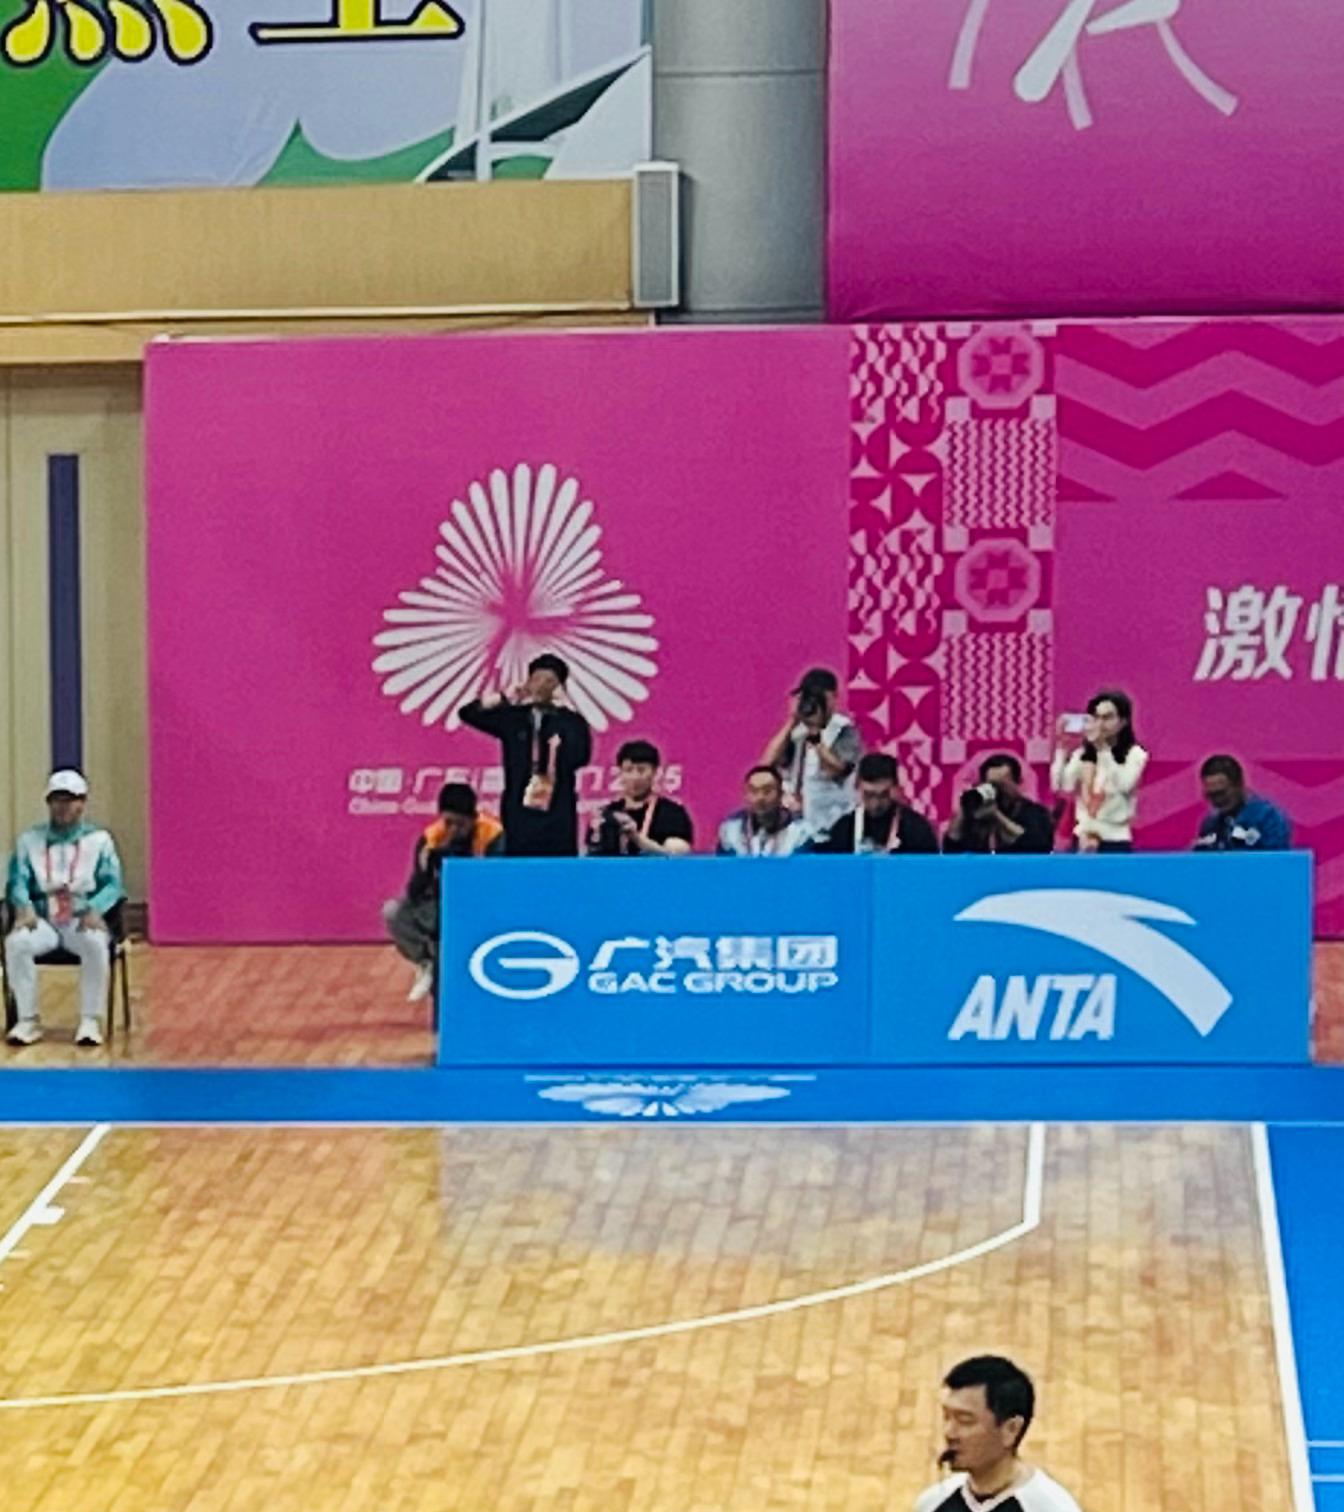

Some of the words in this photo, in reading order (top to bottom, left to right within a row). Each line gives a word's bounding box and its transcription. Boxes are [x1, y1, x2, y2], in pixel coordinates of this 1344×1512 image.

[589, 934, 838, 971] 广汽集团
[588, 971, 677, 995] GAC
[685, 971, 838, 994] GROUP
[947, 974, 1118, 1042] ANTA
